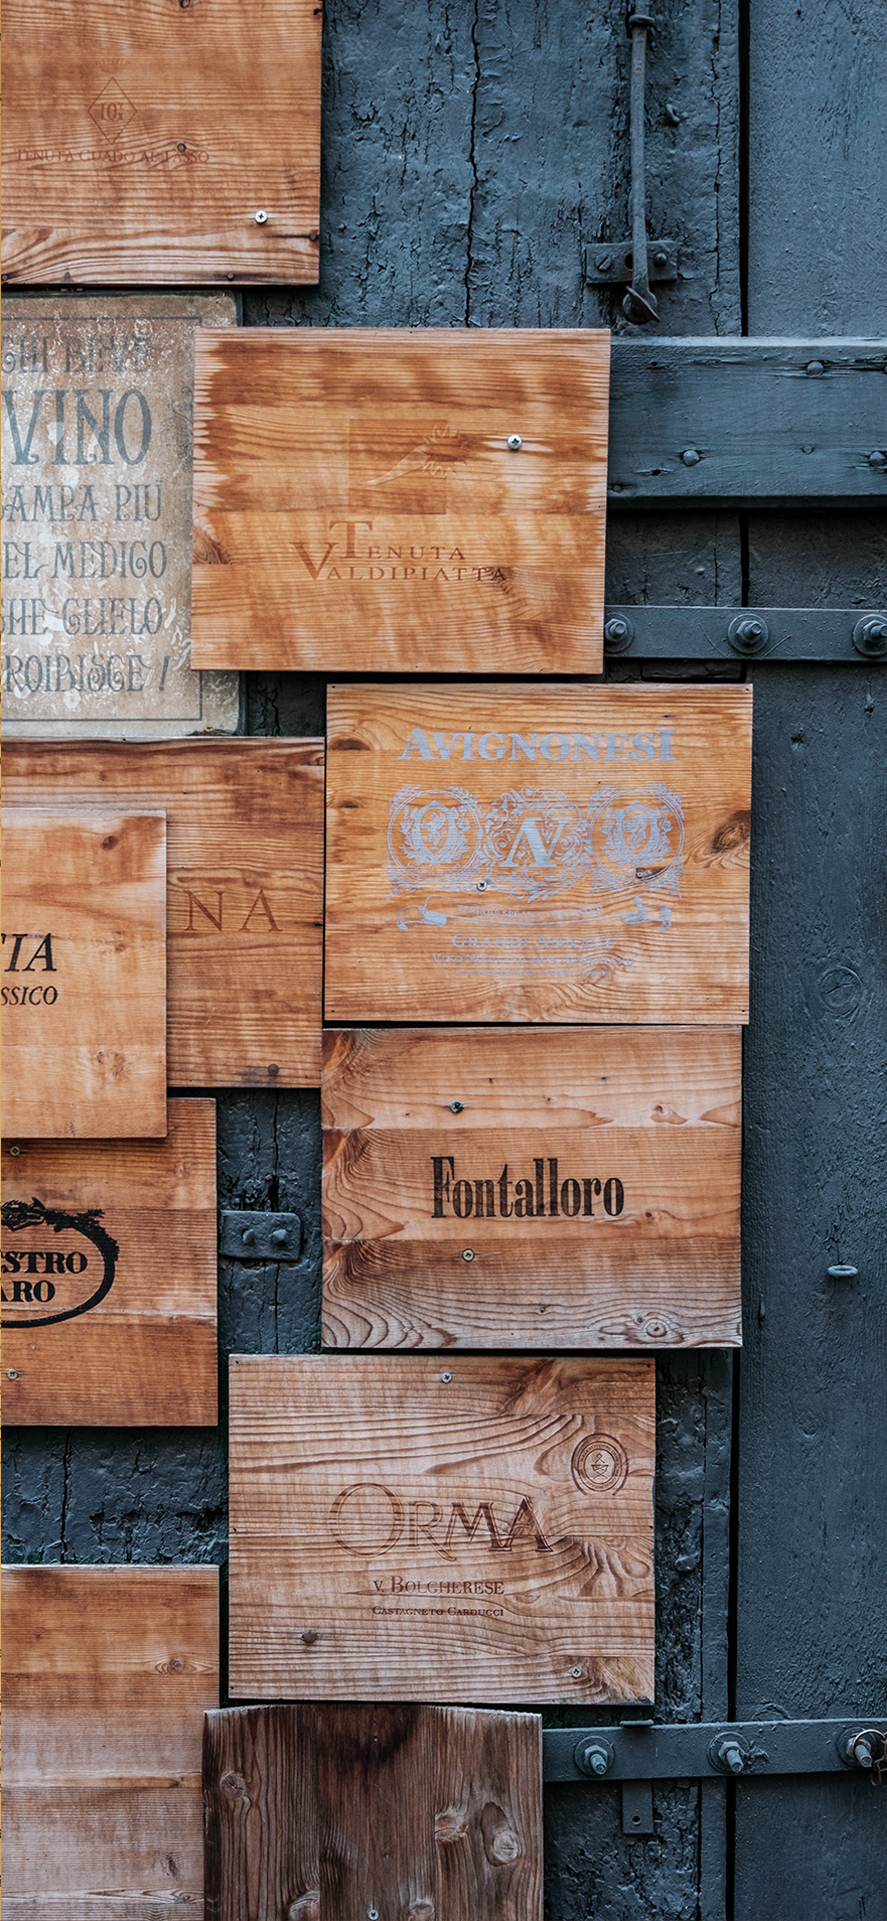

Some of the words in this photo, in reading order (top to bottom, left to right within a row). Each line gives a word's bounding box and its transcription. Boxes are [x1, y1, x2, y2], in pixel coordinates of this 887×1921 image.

[1, 388, 152, 466] VINO
[1, 484, 101, 522] AMPA
[329, 520, 466, 560] TENUTA
[52, 541, 167, 578] MEDICO
[290, 542, 506, 581] VALDIPIATTA
[62, 597, 163, 635] GLIELO
[1, 654, 155, 692] ROIBISCE
[397, 727, 677, 761] AVIGNONESI
[451, 933, 529, 949] GRANDI
[534, 934, 615, 950] ANNATE
[430, 1156, 625, 1219] Fontalloro
[1, 1251, 88, 1274] STRO
[328, 1482, 554, 1562] ORMA
[391, 1575, 505, 1595] BOLGHERESE
[372, 1606, 444, 1616] CASTAGNETO
[447, 1607, 504, 1617] CARDUCCI
